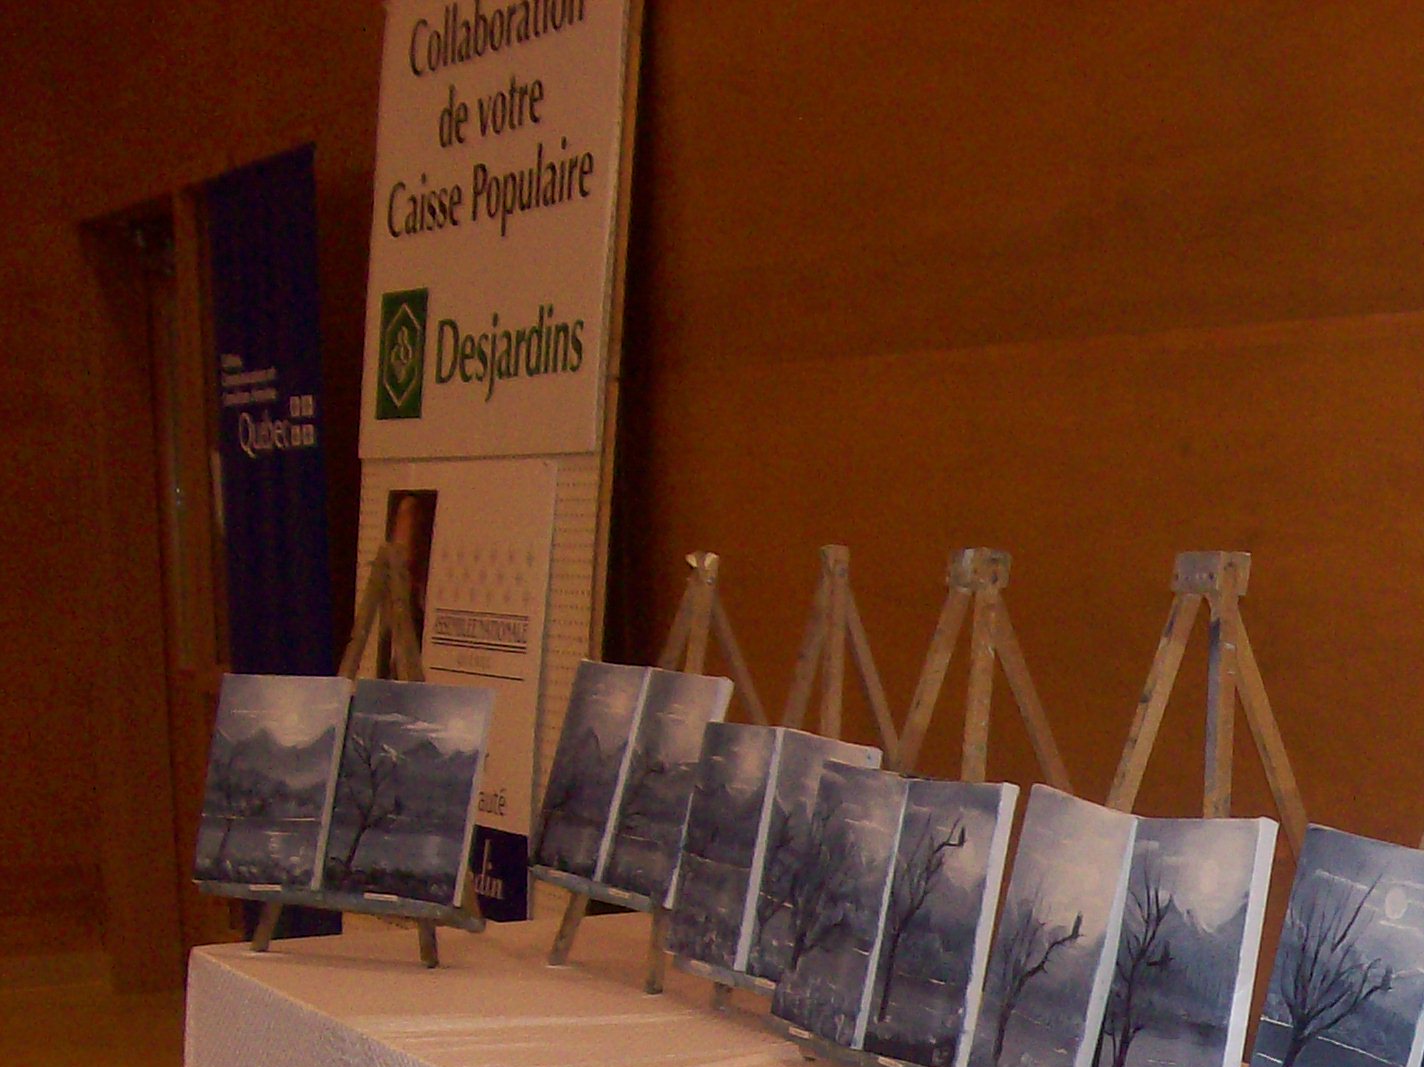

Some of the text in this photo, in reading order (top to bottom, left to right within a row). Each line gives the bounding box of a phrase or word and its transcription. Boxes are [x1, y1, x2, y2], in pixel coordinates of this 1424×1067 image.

[410, 0, 585, 77] Collaboration
[439, 75, 544, 148] de votre
[387, 137, 594, 239] Caisse Populaire
[434, 304, 584, 402] Desjardins
